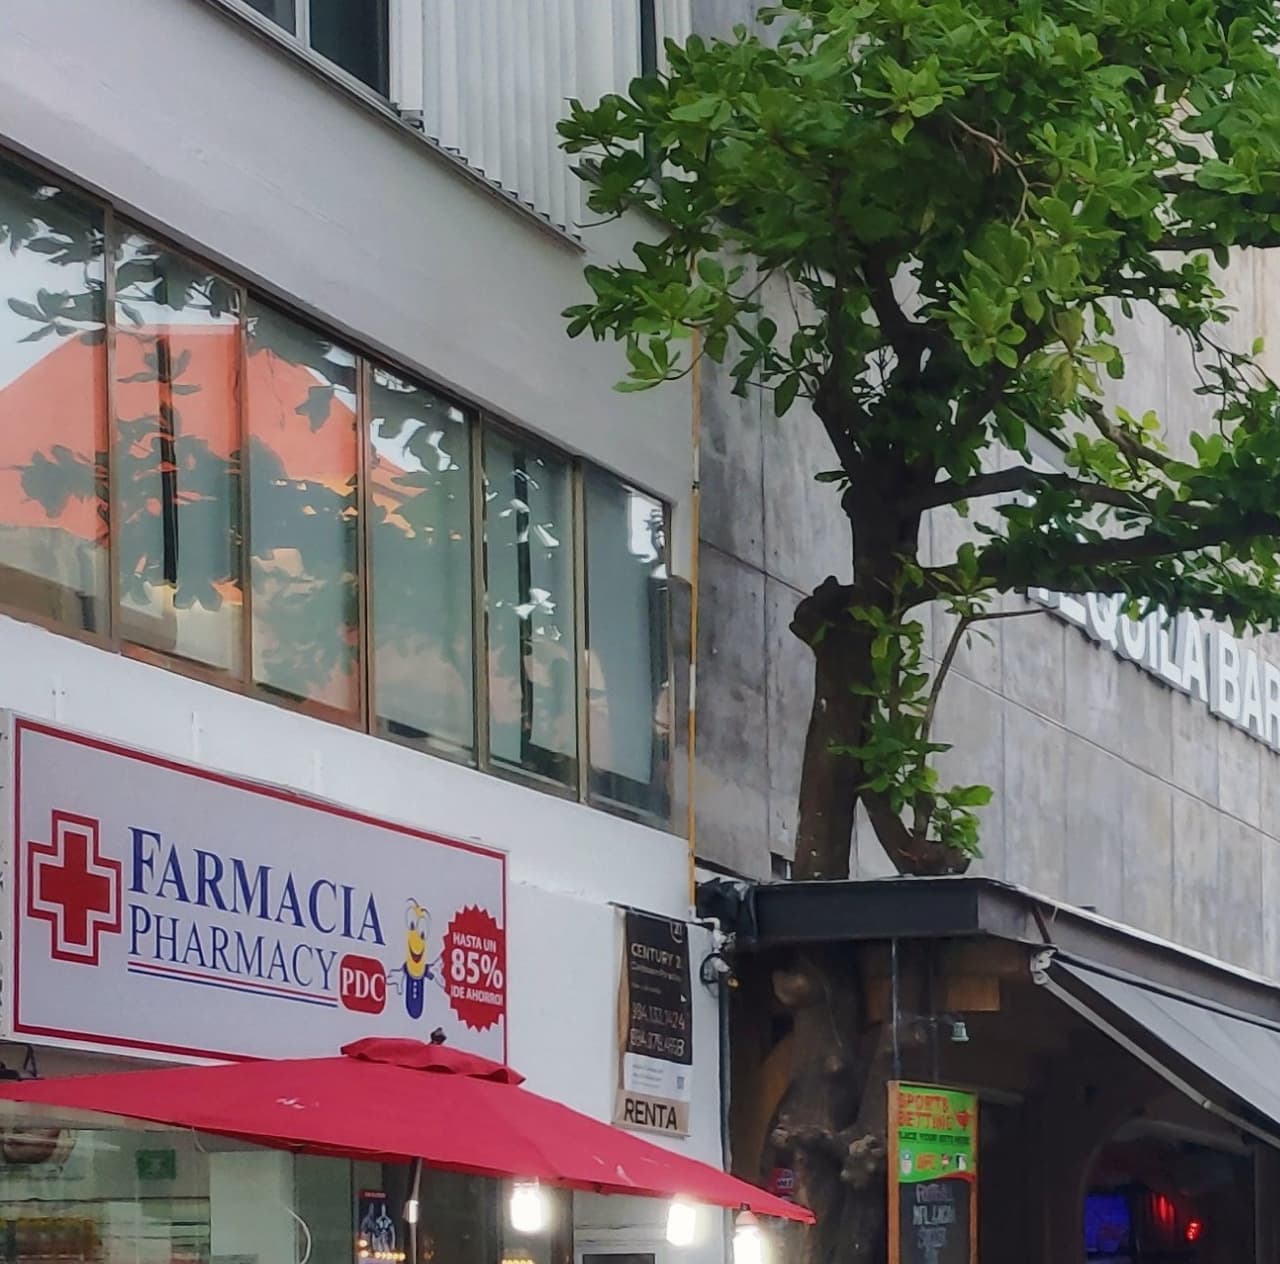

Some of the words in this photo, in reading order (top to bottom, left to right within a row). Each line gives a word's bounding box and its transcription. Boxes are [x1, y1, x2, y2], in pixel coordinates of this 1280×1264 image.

[1028, 587, 1209, 702] QUILA
[127, 826, 387, 946] FARMACIA
[127, 904, 338, 991] PHARMACY
[453, 931, 482, 951] HASTA
[483, 938, 497, 954] UN
[341, 967, 386, 1003] PDC
[450, 948, 504, 989] 85%
[623, 1097, 678, 1131] RENTA
